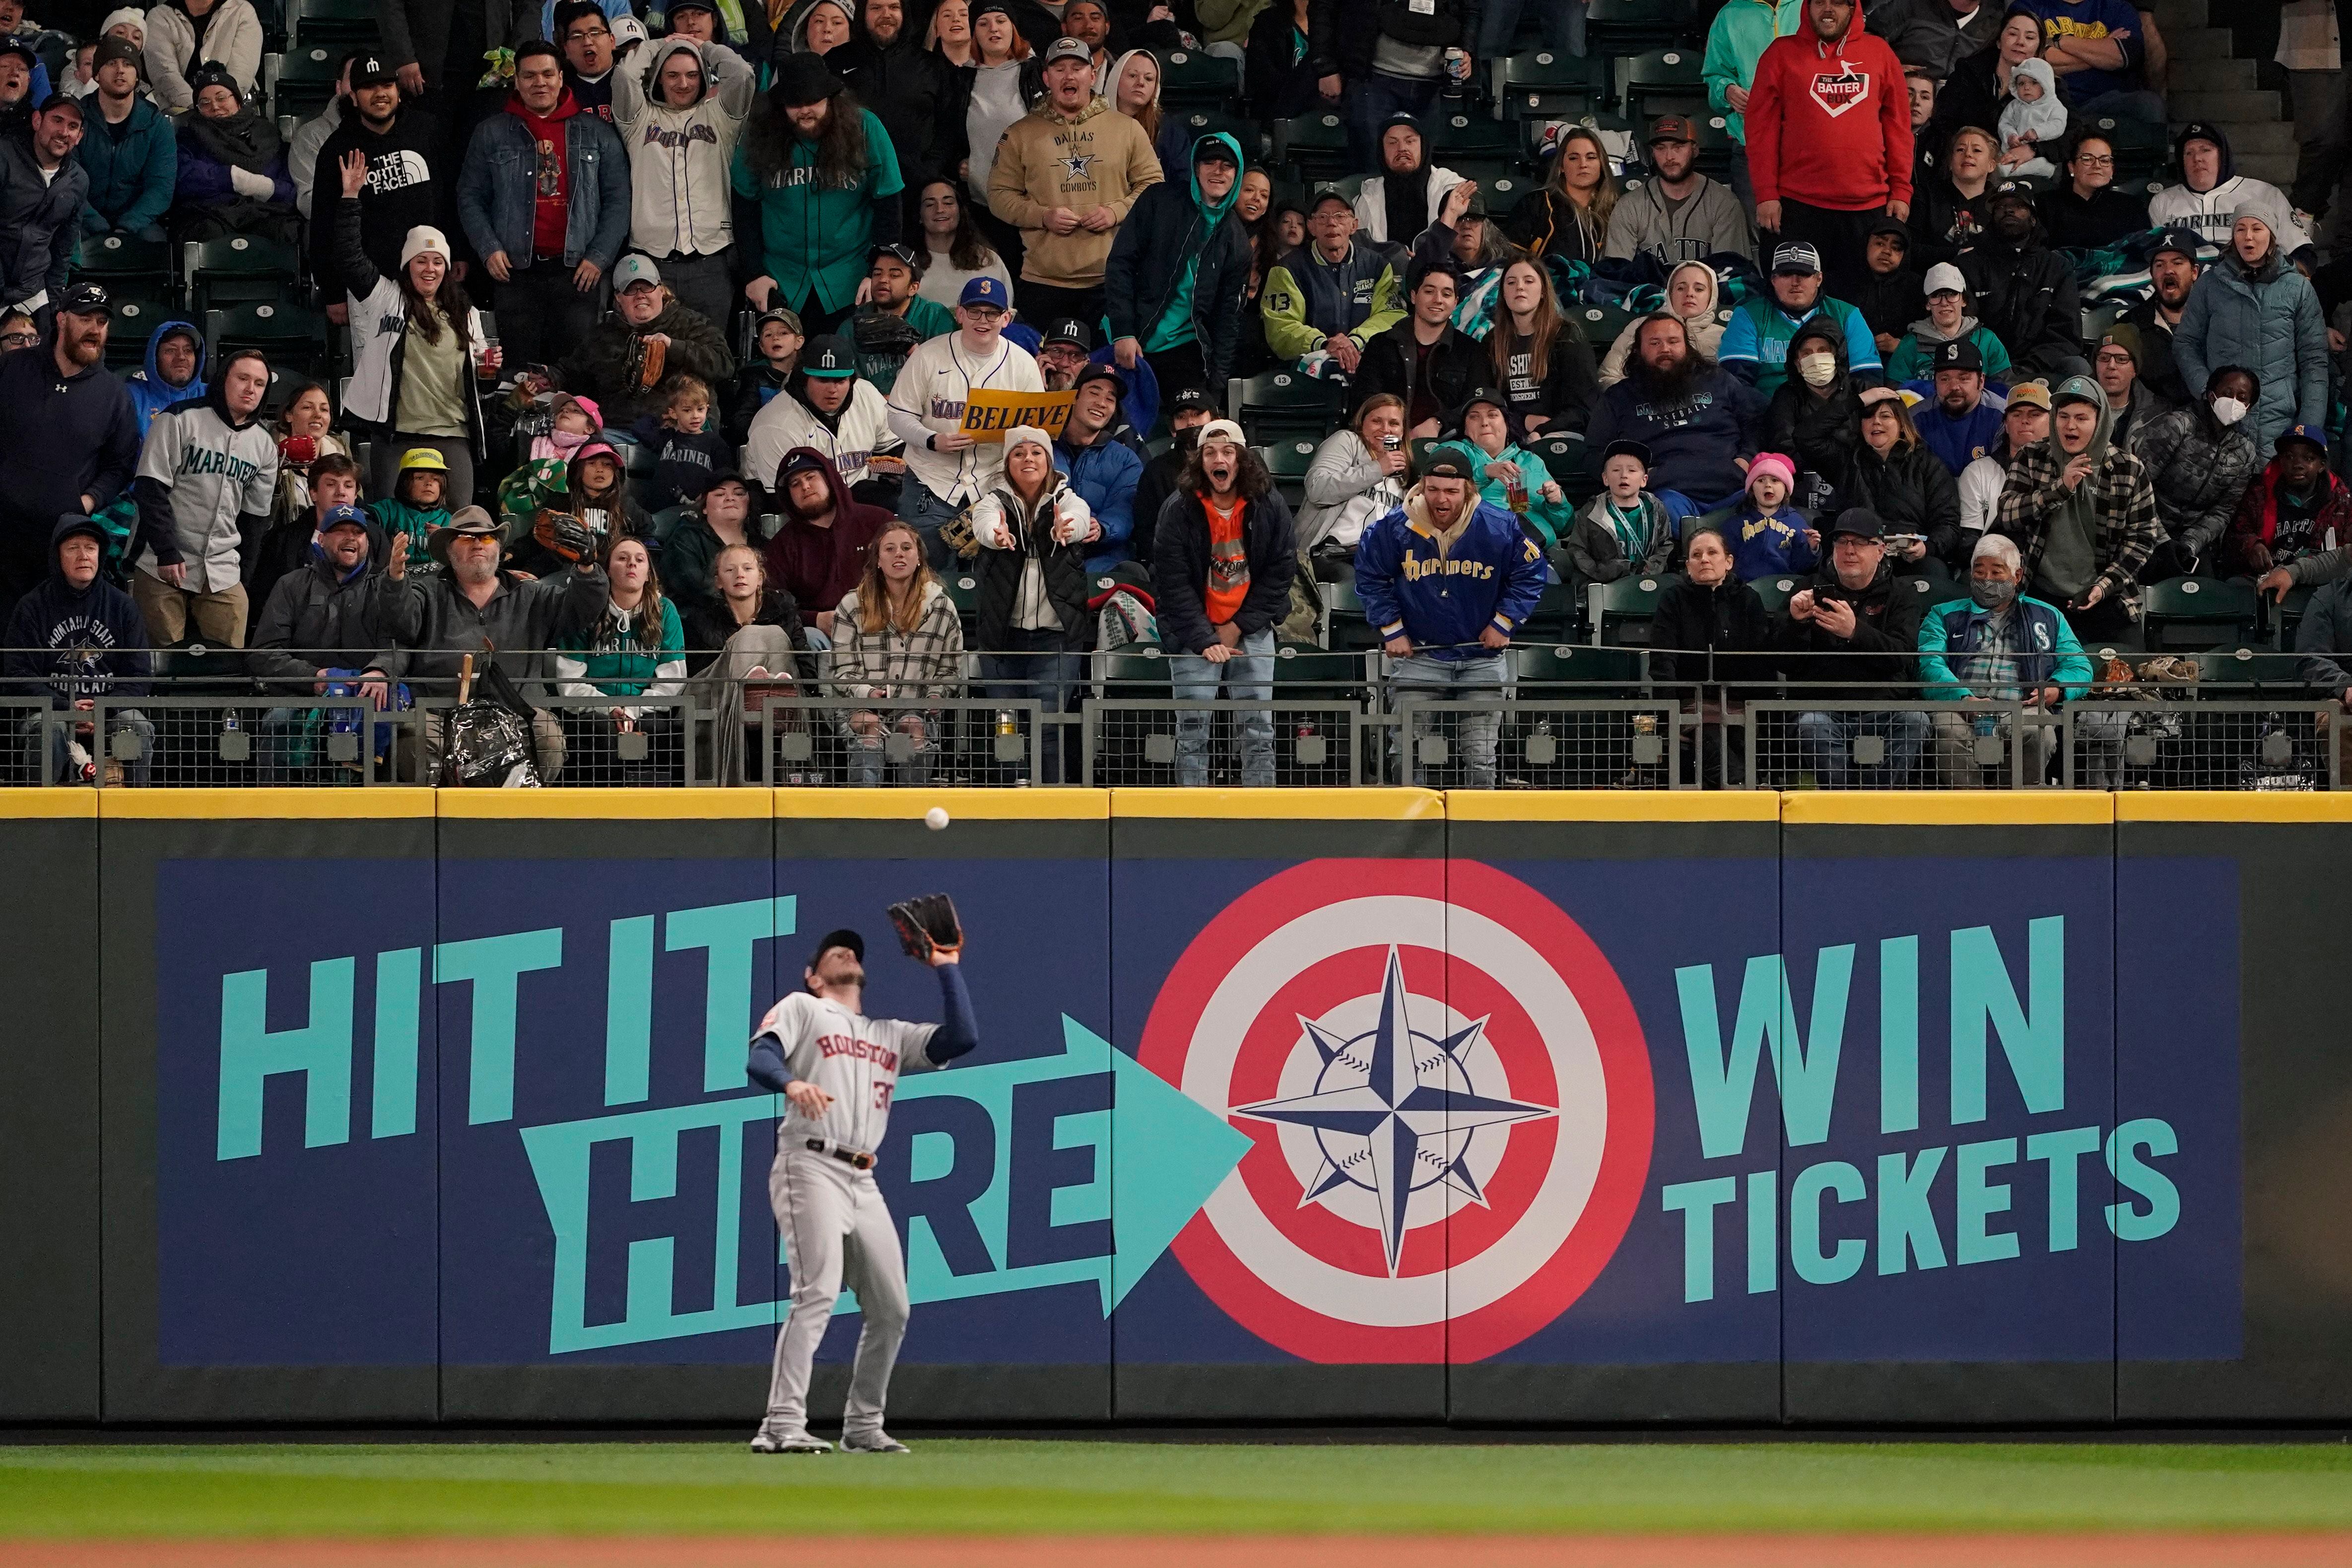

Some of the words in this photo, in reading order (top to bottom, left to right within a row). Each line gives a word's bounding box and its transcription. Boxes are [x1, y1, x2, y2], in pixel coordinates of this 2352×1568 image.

[1817, 82, 1860, 94] BATTER
[1827, 93, 1852, 105] BOX
[1054, 132, 1095, 146] DALLAS
[365, 159, 405, 186] ORTH
[373, 152, 401, 171] THE
[373, 176, 408, 195] FACE
[1060, 181, 1097, 194] COWBOYS
[964, 405, 1069, 431] BELIEVE
[89, 619, 116, 649] STATE
[217, 928, 563, 1161] HIT
[605, 895, 797, 1106] IT
[1675, 915, 2065, 1158] WIN
[816, 1034, 898, 1072] HOUSTON
[1664, 1118, 2180, 1303] TICKETS
